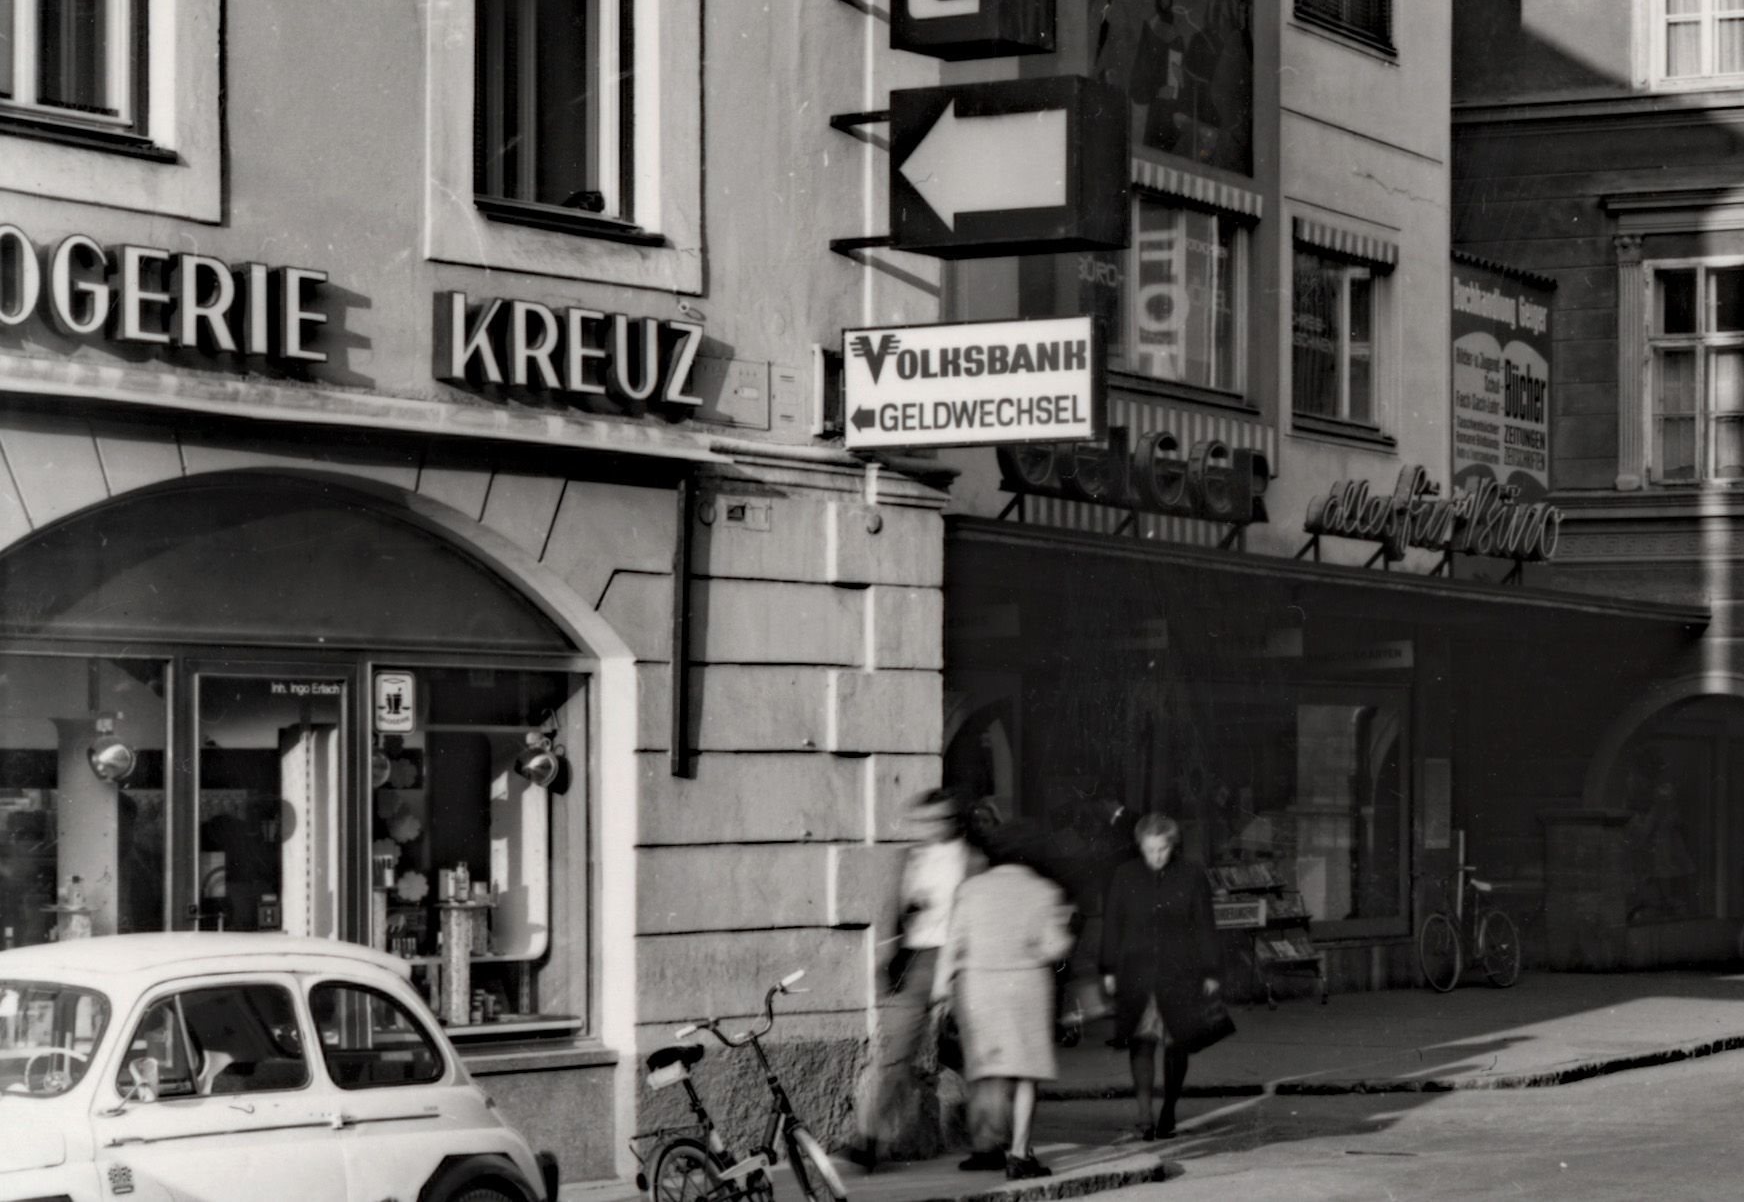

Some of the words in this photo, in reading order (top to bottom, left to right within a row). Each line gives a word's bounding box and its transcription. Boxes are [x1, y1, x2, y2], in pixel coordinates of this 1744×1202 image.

[0, 221, 328, 363] OGERIE
[434, 289, 704, 406] KREUZ
[849, 333, 1087, 386] VOLKSBANK
[879, 394, 1087, 432] GELDWECHSEL
[1504, 358, 1547, 425] Bücher
[1503, 424, 1546, 451] ZEITUNGEN
